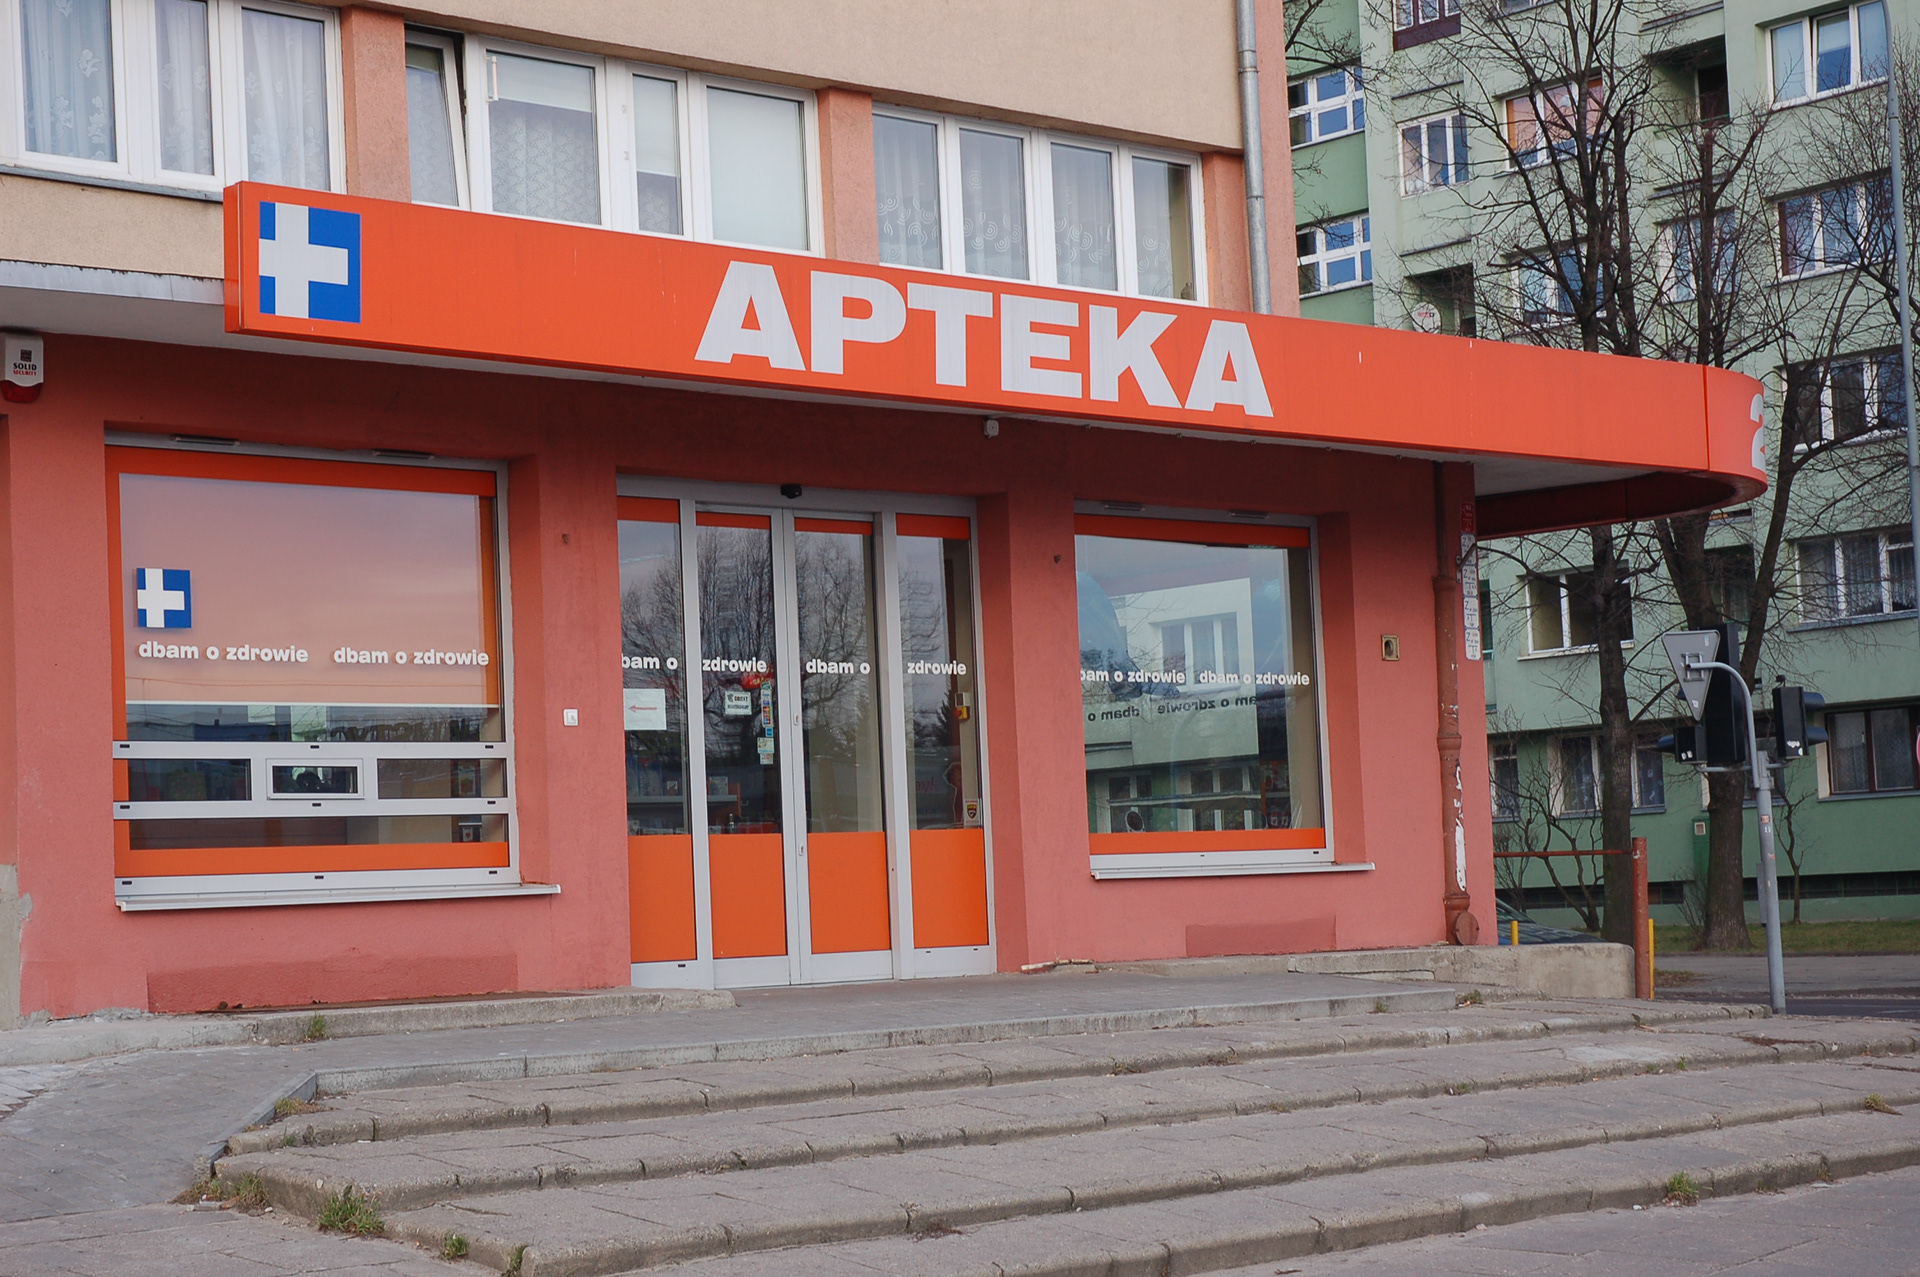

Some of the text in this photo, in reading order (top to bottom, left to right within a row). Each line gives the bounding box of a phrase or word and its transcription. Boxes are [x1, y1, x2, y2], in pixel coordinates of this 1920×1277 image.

[694, 260, 1274, 418] APTEKA
[13, 362, 37, 370] SOLID
[139, 641, 309, 663] dbam o zdrowie
[334, 646, 489, 666] dbam o zdrowie
[621, 653, 767, 673] bam o zdrowie
[805, 658, 967, 675] dbam o zdrowie
[1114, 670, 1124, 683] o
[1127, 669, 1186, 684] zdrowie
[1199, 670, 1310, 686] dbam o zdrowie
